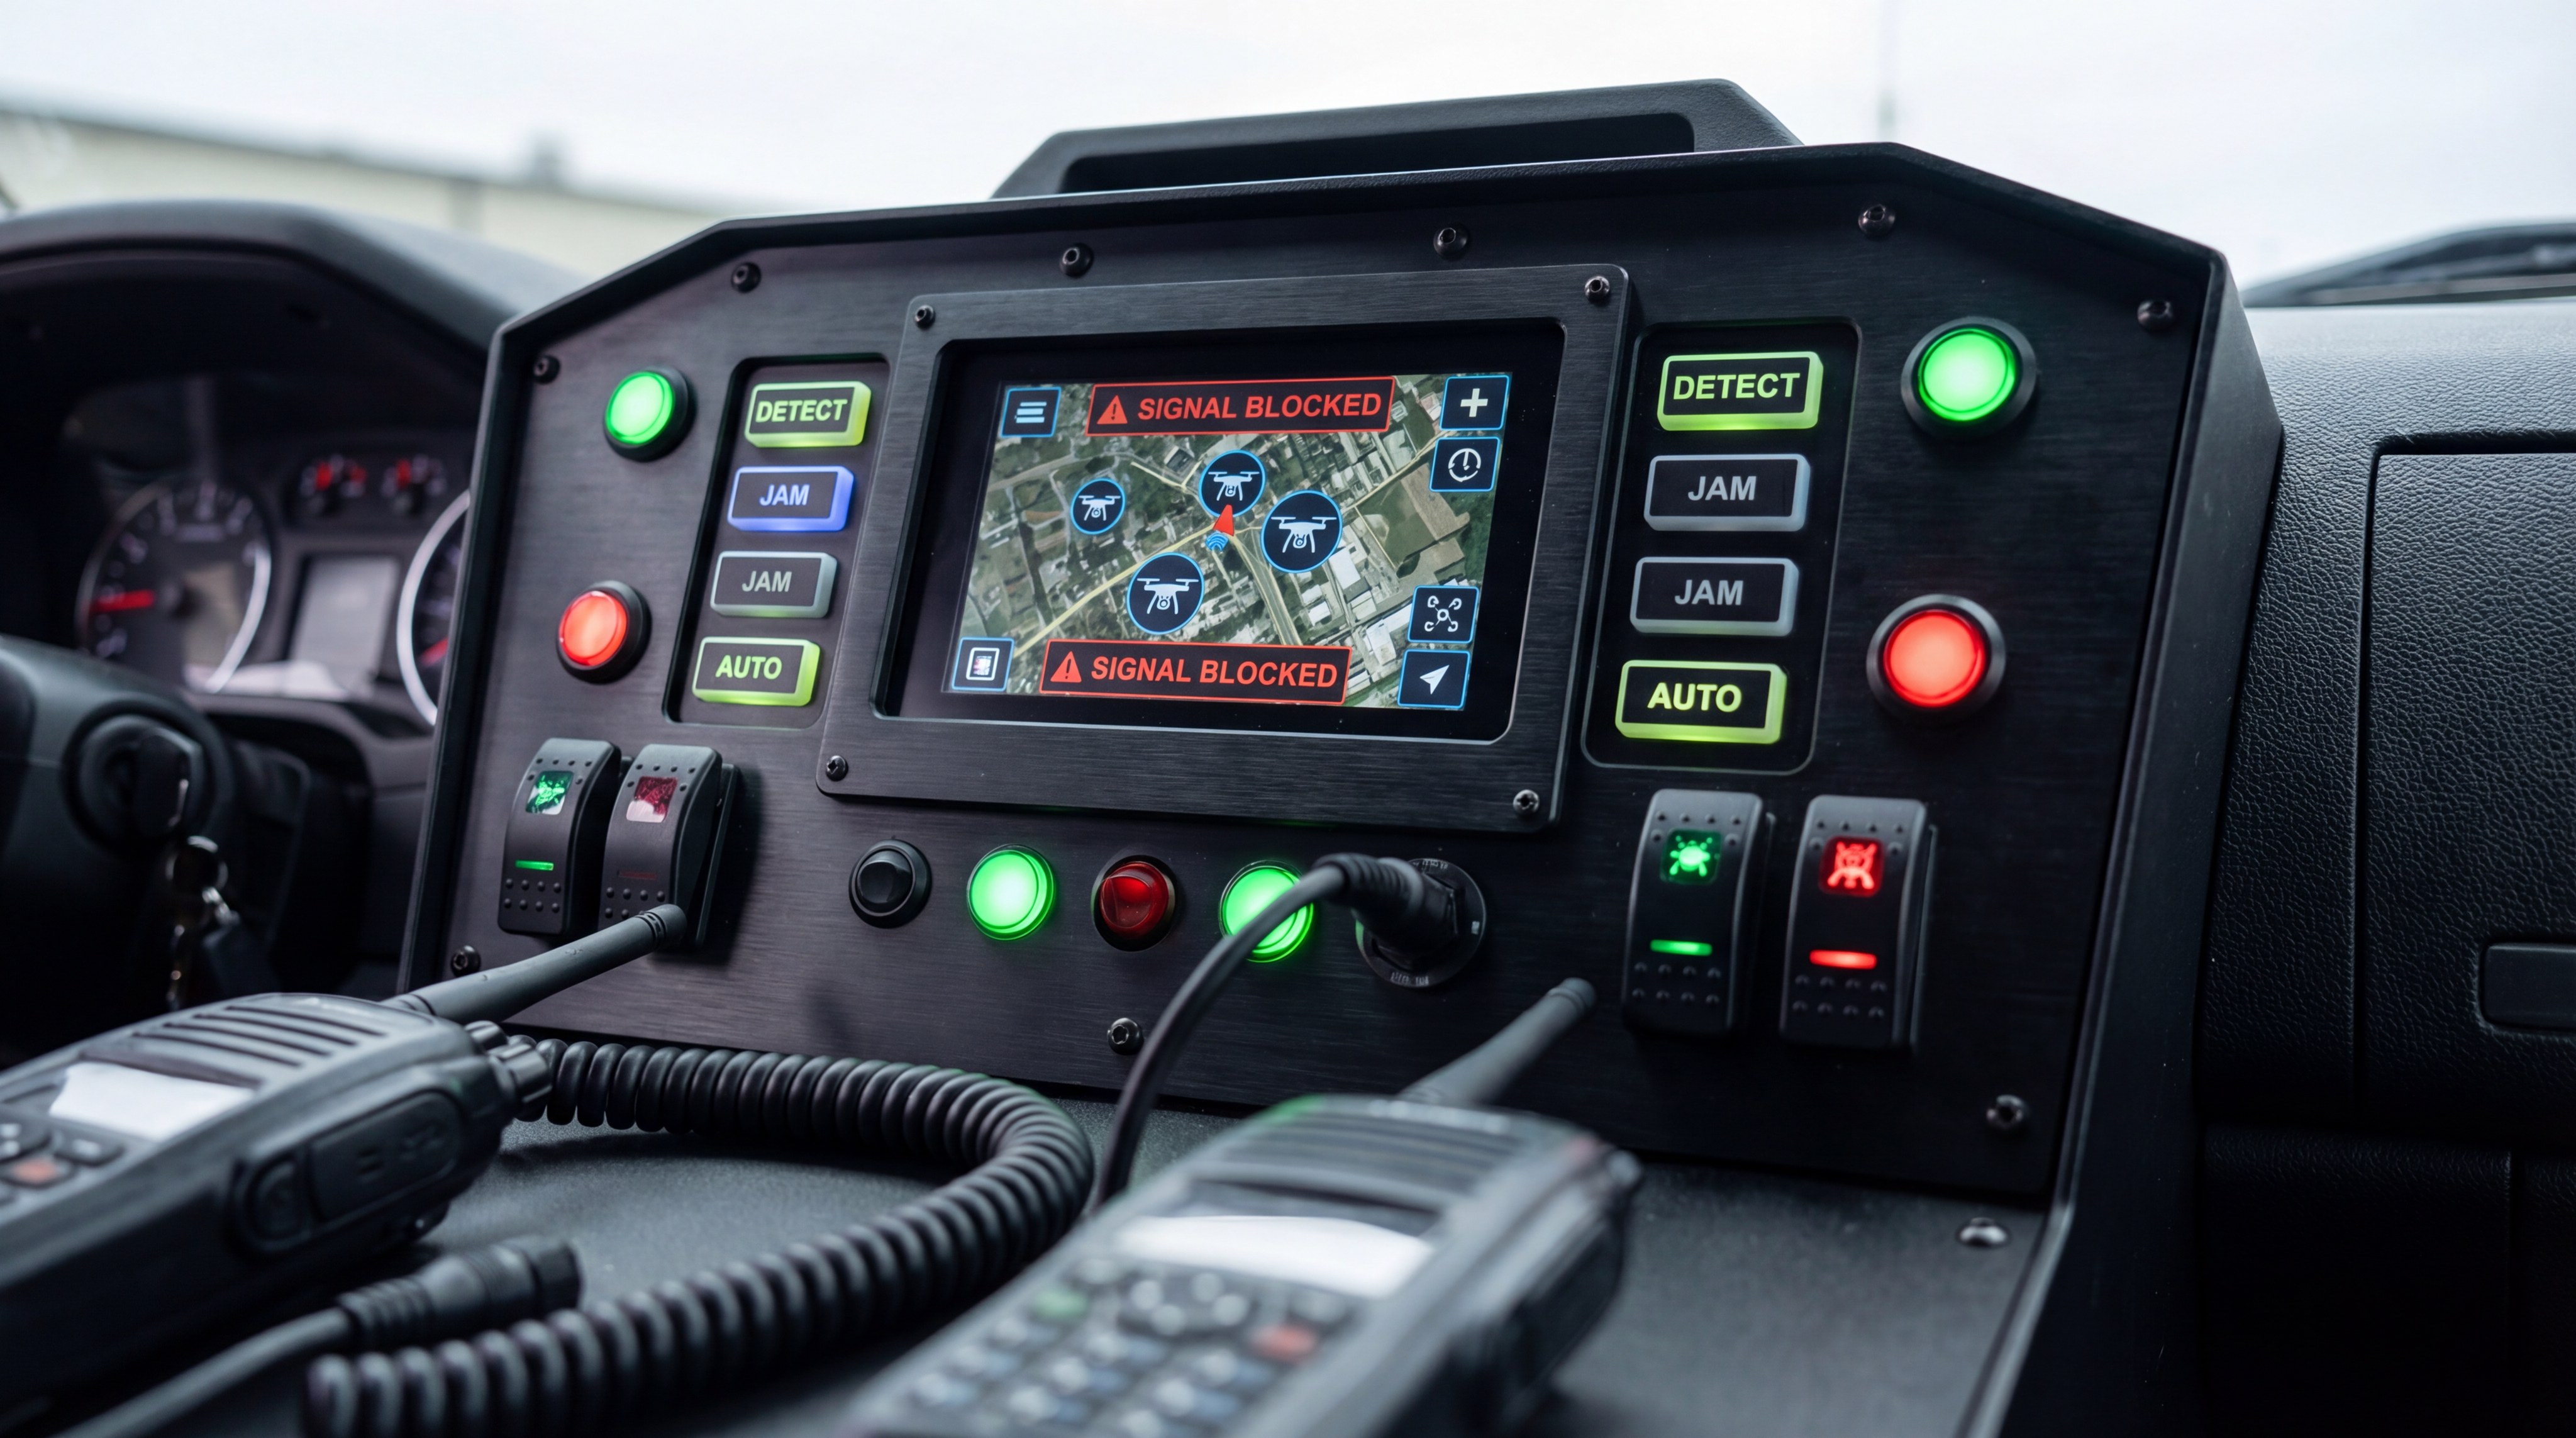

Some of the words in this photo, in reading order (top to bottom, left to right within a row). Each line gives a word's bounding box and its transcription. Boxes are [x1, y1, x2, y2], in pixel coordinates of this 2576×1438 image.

[1673, 372, 1801, 400] DETECT
[755, 399, 848, 423] DETECT
[1137, 396, 1238, 420] SIGNAL
[1245, 394, 1382, 418] BLOCKED
[759, 484, 810, 507] JAM
[1687, 476, 1757, 501] JAM
[741, 571, 792, 593] JAM
[1674, 579, 1744, 606] JAM
[715, 655, 782, 679] AUTO
[1091, 655, 1192, 682] SIGNAL
[1199, 660, 1338, 688] BLOCKED
[1647, 683, 1743, 712] AUTO
